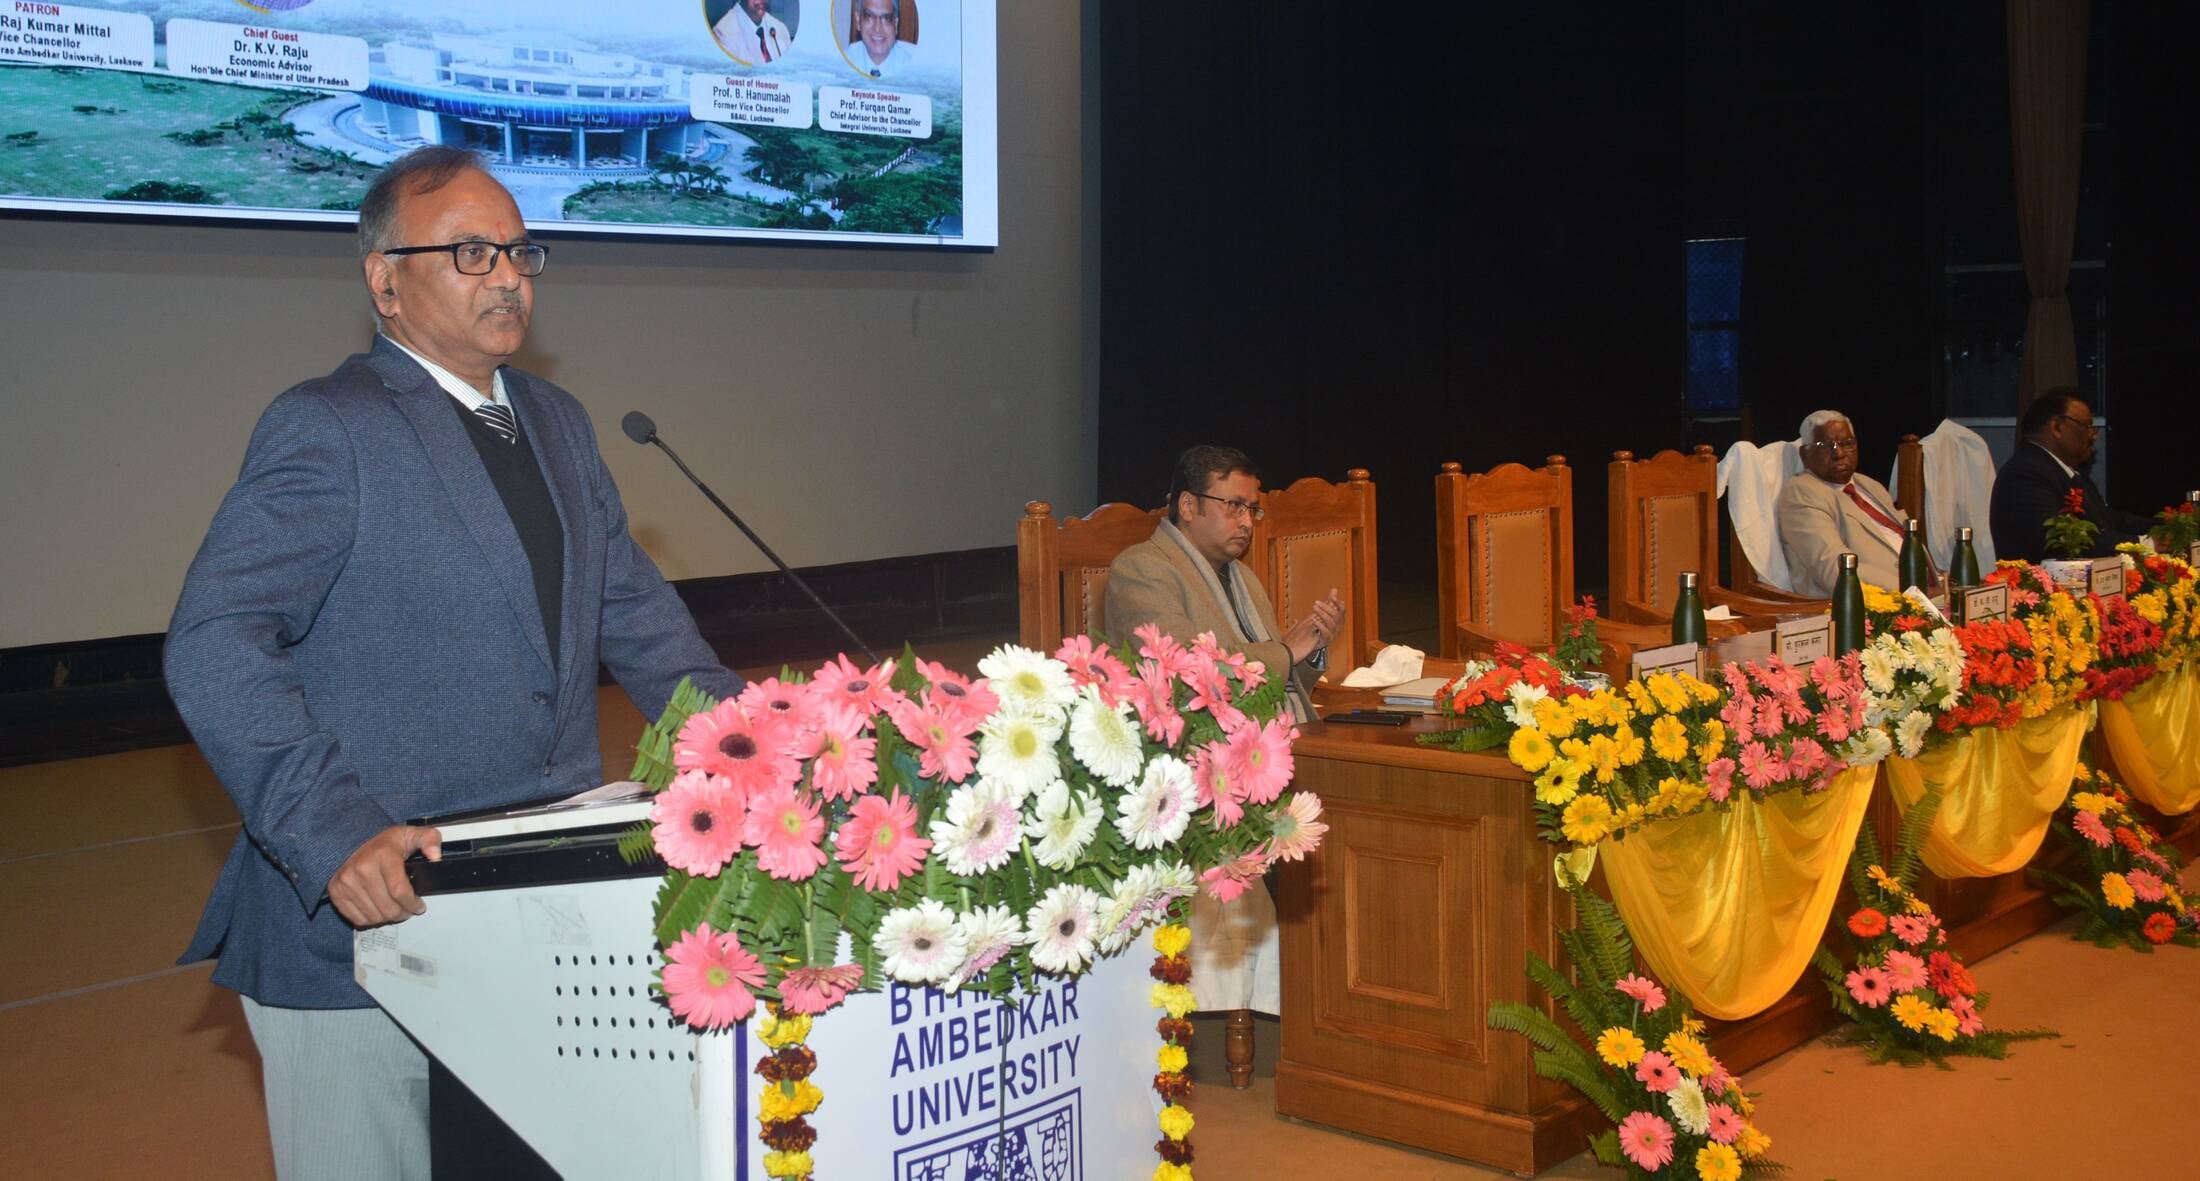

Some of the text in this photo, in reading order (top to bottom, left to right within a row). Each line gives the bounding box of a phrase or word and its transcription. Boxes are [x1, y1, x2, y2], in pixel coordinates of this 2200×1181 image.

[15, 1, 60, 16] PATRON
[1, 15, 111, 38] Raj Kumar Mittal
[243, 27, 299, 42] Chief Guest
[23, 33, 80, 49] Chancellor
[17, 47, 60, 60] Ambedkar
[234, 40, 309, 60] Dr. K.V. Raju
[229, 55, 313, 72] Economic Advisor
[225, 67, 247, 77] Chief
[250, 70, 283, 81] Minister
[286, 73, 294, 82] of
[297, 74, 316, 84] Uttar
[318, 76, 350, 87] Pradesh
[725, 77, 779, 90] Guest of Honour
[713, 86, 791, 104] Prof. B. Hanumaiah
[851, 90, 901, 102] Keynote Speaker
[713, 100, 790, 115] Former Vice Chancellor
[840, 99, 912, 115] Prof. Furqan Qamar
[830, 110, 922, 126] Chief Advisor to the Chancellor
[890, 981, 1080, 1078] AMBEDKAR
[891, 1034, 1082, 1136] UNIVERSITY
